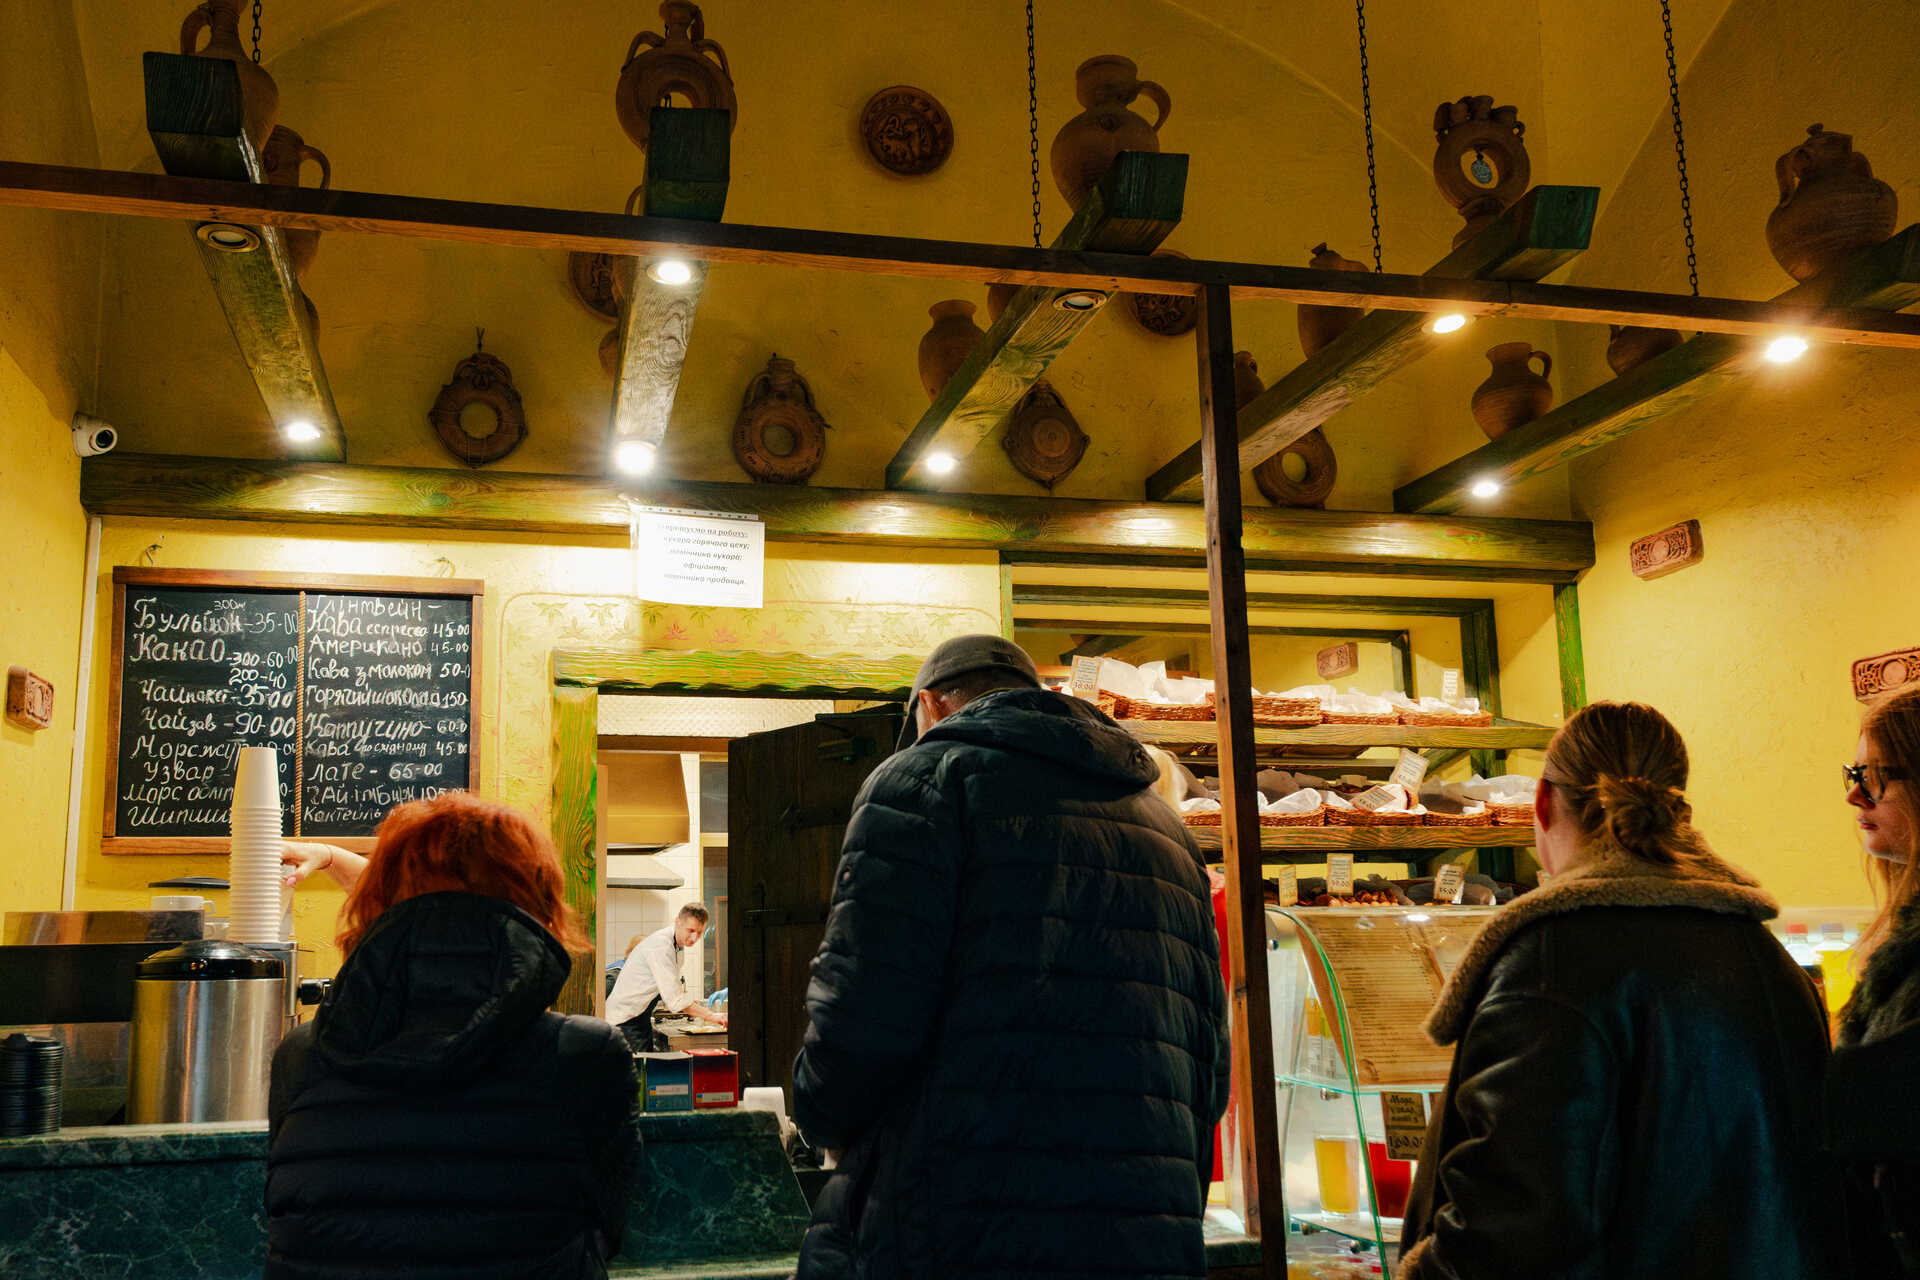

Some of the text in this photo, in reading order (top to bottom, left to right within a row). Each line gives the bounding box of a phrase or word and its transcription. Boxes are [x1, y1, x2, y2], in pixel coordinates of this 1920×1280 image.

[307, 608, 362, 637] Кава
[130, 632, 226, 663] Какао
[308, 634, 423, 657] Американо
[308, 656, 349, 679] Кава
[305, 737, 352, 757] Кава
[144, 760, 214, 784] Узвар
